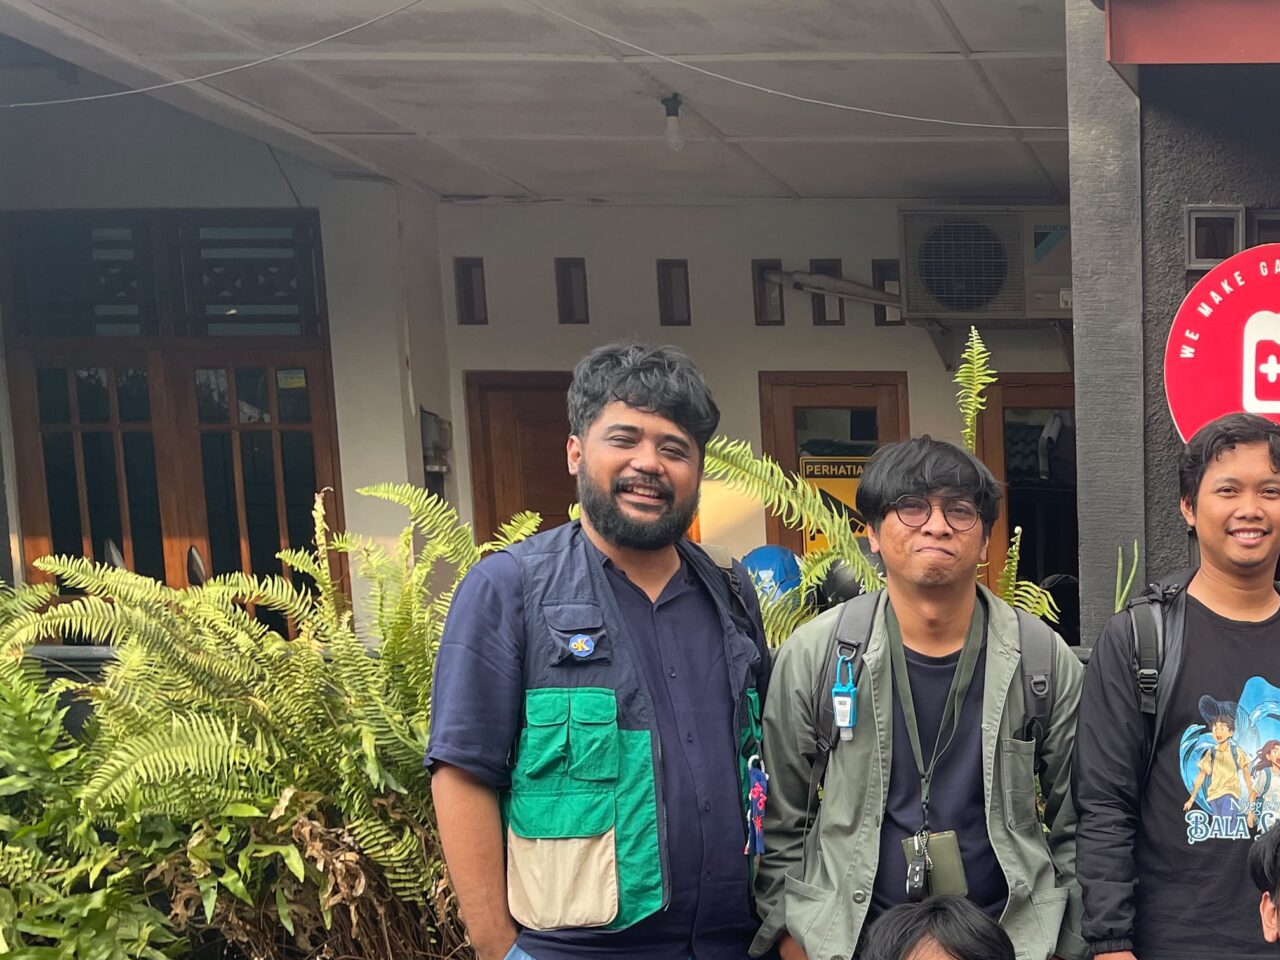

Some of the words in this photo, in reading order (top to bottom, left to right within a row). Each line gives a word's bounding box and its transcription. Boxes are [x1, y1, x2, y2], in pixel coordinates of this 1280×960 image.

[1180, 329, 1200, 358] WE
[1197, 271, 1246, 318] MAKE
[806, 464, 864, 475] PERHATIA
[1185, 810, 1251, 845] BALA
